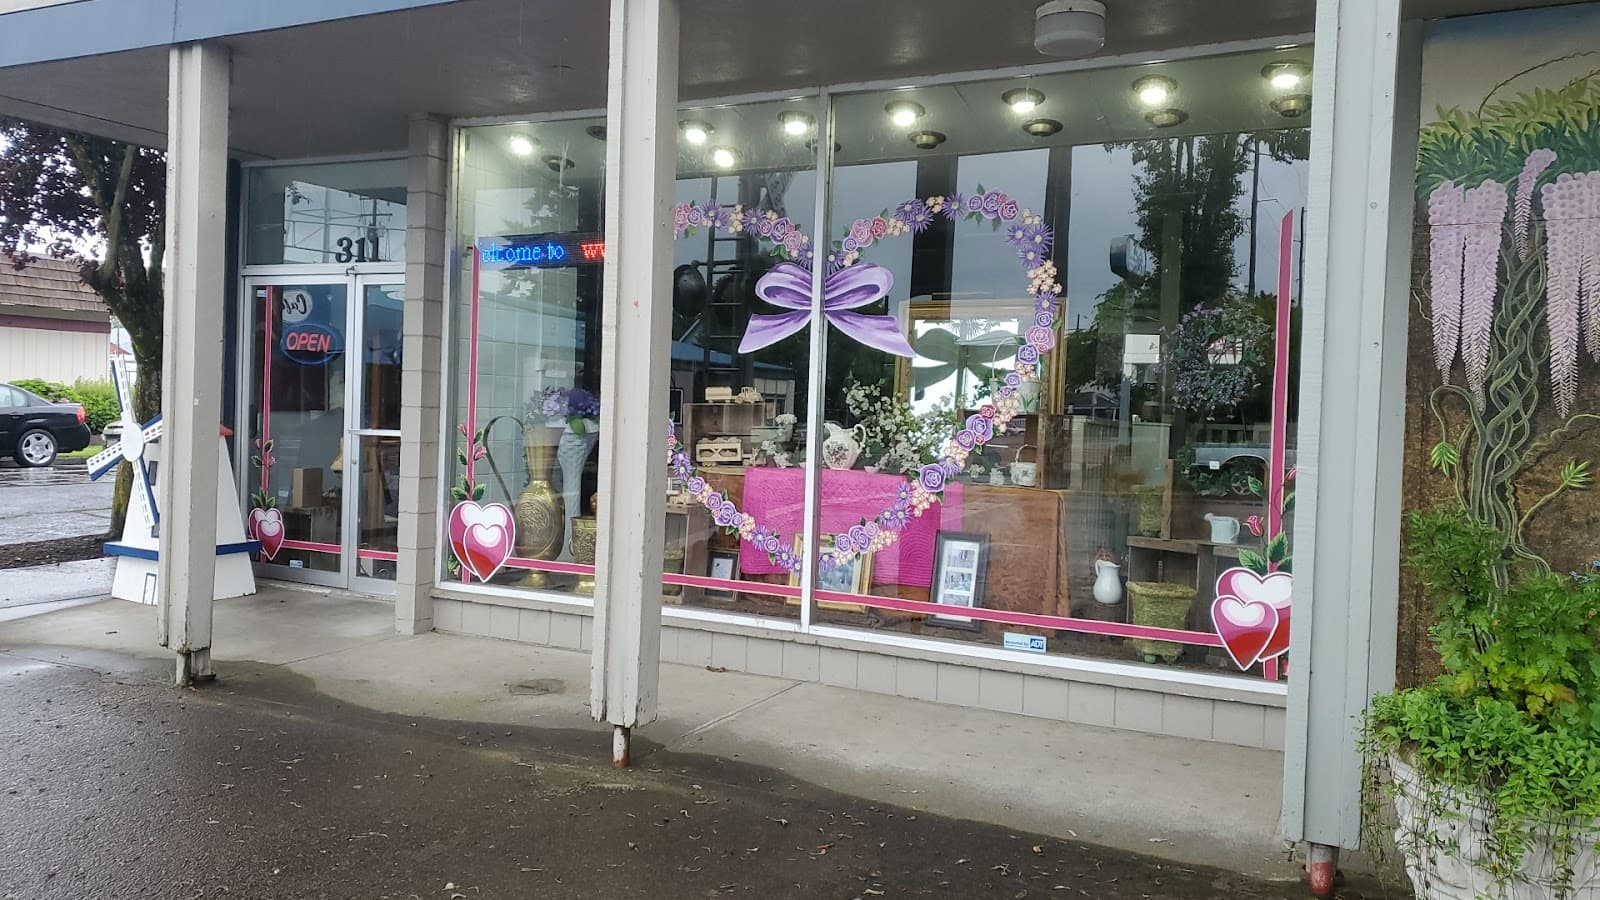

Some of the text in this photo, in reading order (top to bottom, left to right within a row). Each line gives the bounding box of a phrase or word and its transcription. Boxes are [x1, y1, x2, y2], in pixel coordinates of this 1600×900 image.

[335, 236, 380, 263] 311
[480, 241, 541, 262] elcome
[547, 241, 566, 260] to
[286, 331, 331, 353] OPEN
[1030, 639, 1044, 649] ADT
